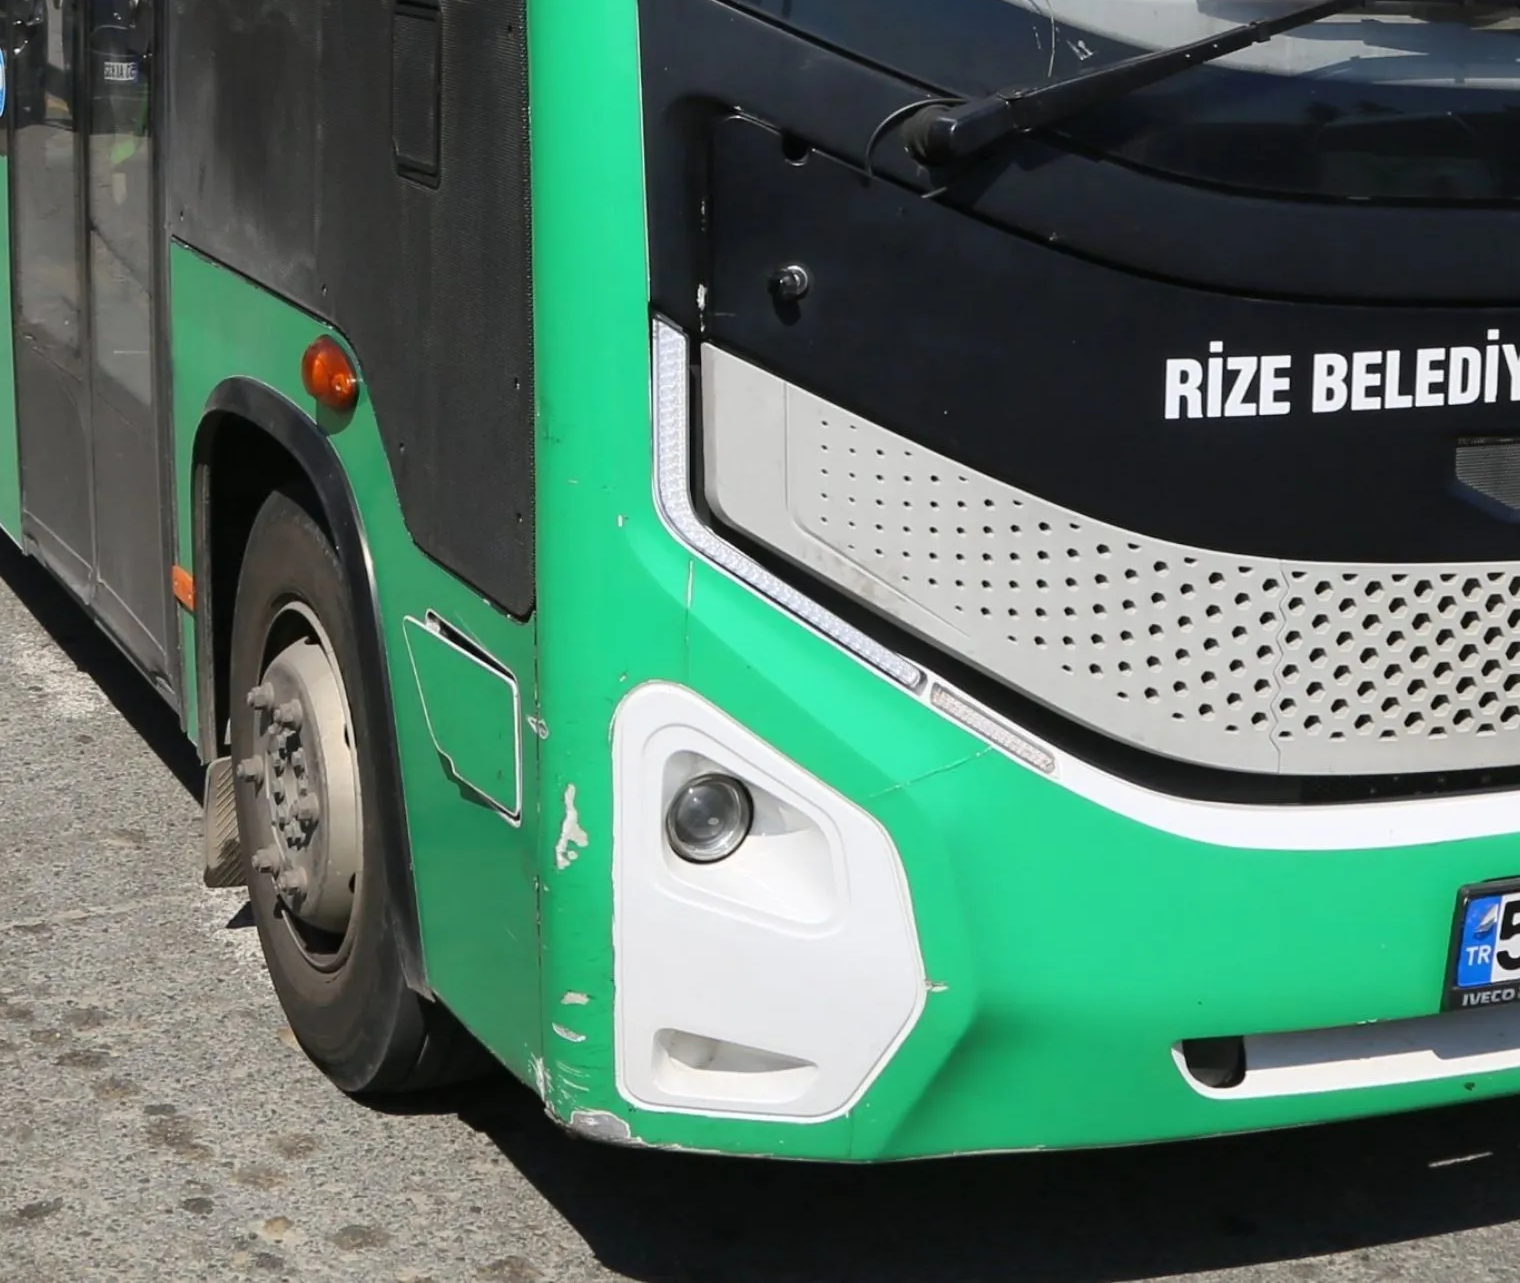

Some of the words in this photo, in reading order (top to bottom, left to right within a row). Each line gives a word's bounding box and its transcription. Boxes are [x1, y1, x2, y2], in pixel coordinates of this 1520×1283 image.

[1163, 340, 1292, 420] RİZE
[1465, 944, 1492, 967] TR
[1461, 987, 1516, 1007] IVECO
